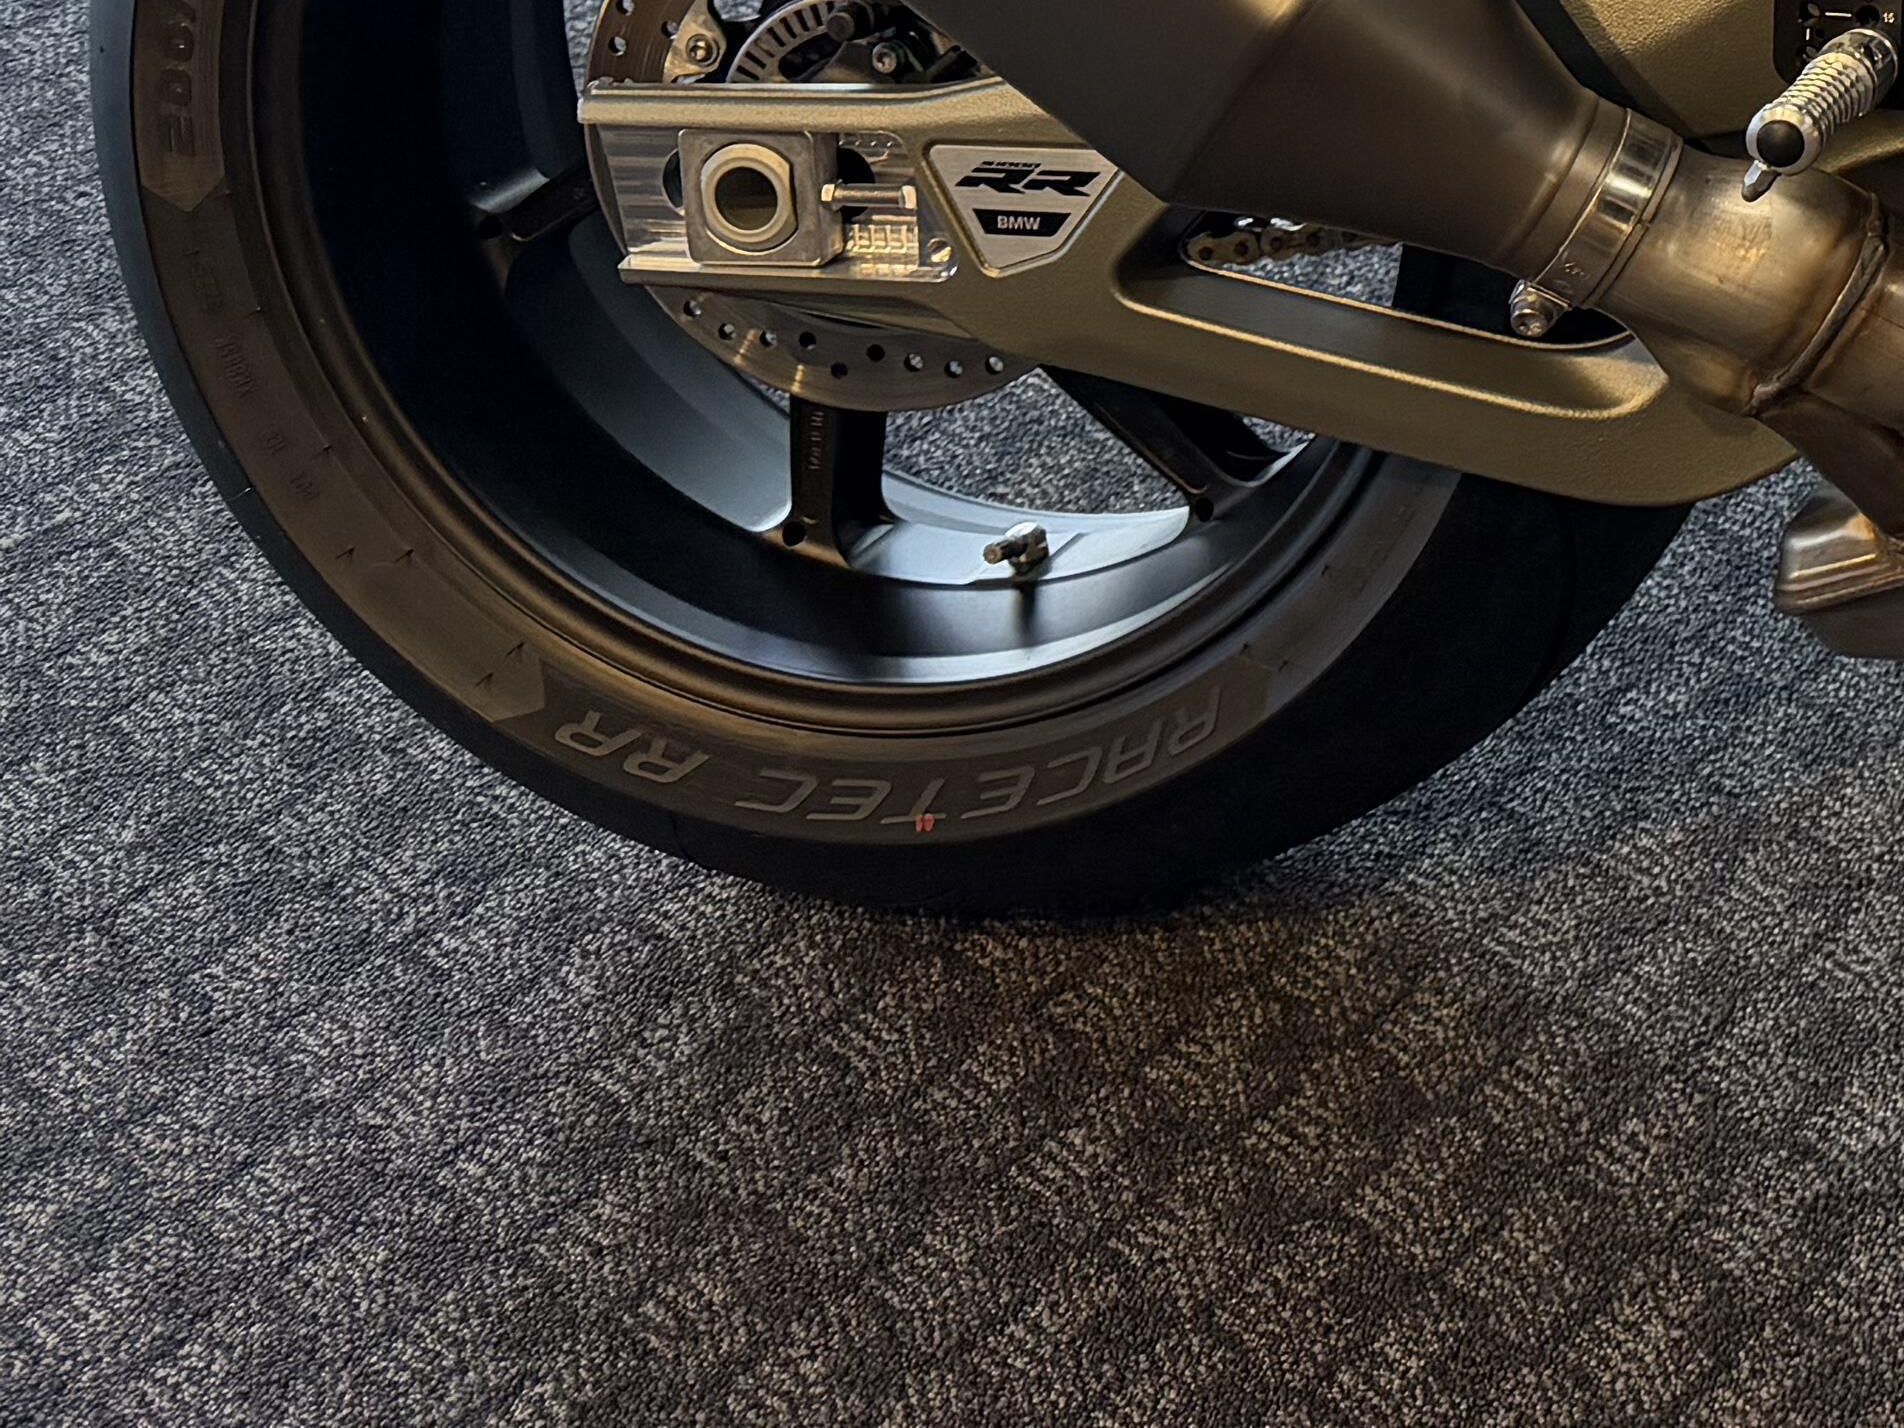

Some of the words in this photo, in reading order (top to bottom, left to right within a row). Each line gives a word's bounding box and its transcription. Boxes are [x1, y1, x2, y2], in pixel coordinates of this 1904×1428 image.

[955, 165, 1102, 198] RR
[996, 214, 1042, 231] BMW
[555, 707, 714, 787] RR
[735, 687, 1223, 825] RACETEC
